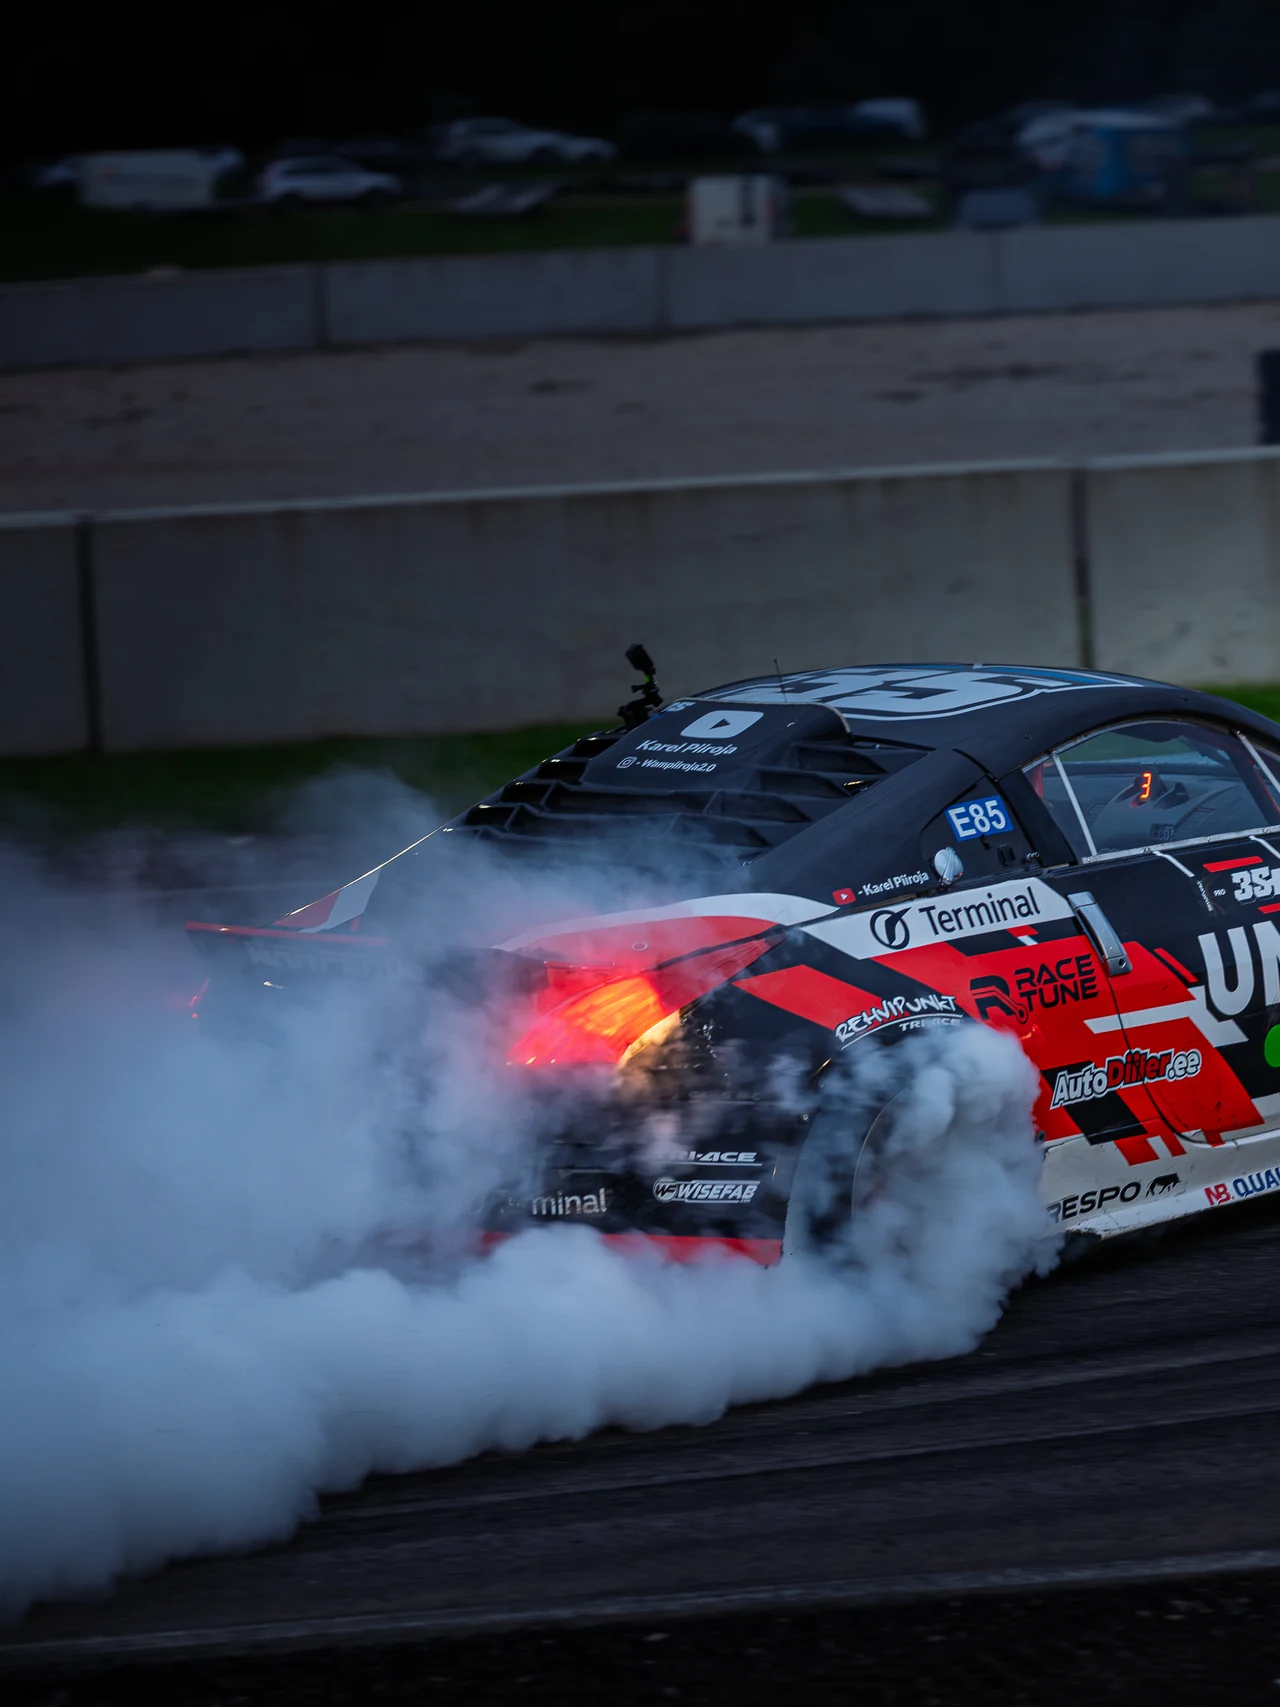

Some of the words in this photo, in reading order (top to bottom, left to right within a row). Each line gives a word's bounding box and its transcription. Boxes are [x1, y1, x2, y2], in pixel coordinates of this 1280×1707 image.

[635, 739, 687, 754] Karel
[1139, 771, 1153, 800] 3
[947, 799, 1007, 838] E85
[863, 878, 894, 897] Karel
[893, 869, 931, 891] Piiroja
[1231, 866, 1274, 904] 35
[919, 886, 1042, 936] Terminal
[1014, 953, 1097, 990] RACE
[1020, 976, 1099, 1011] TUNE
[507, 1187, 608, 1216] minal
[677, 1183, 758, 1200] WISEFAB
